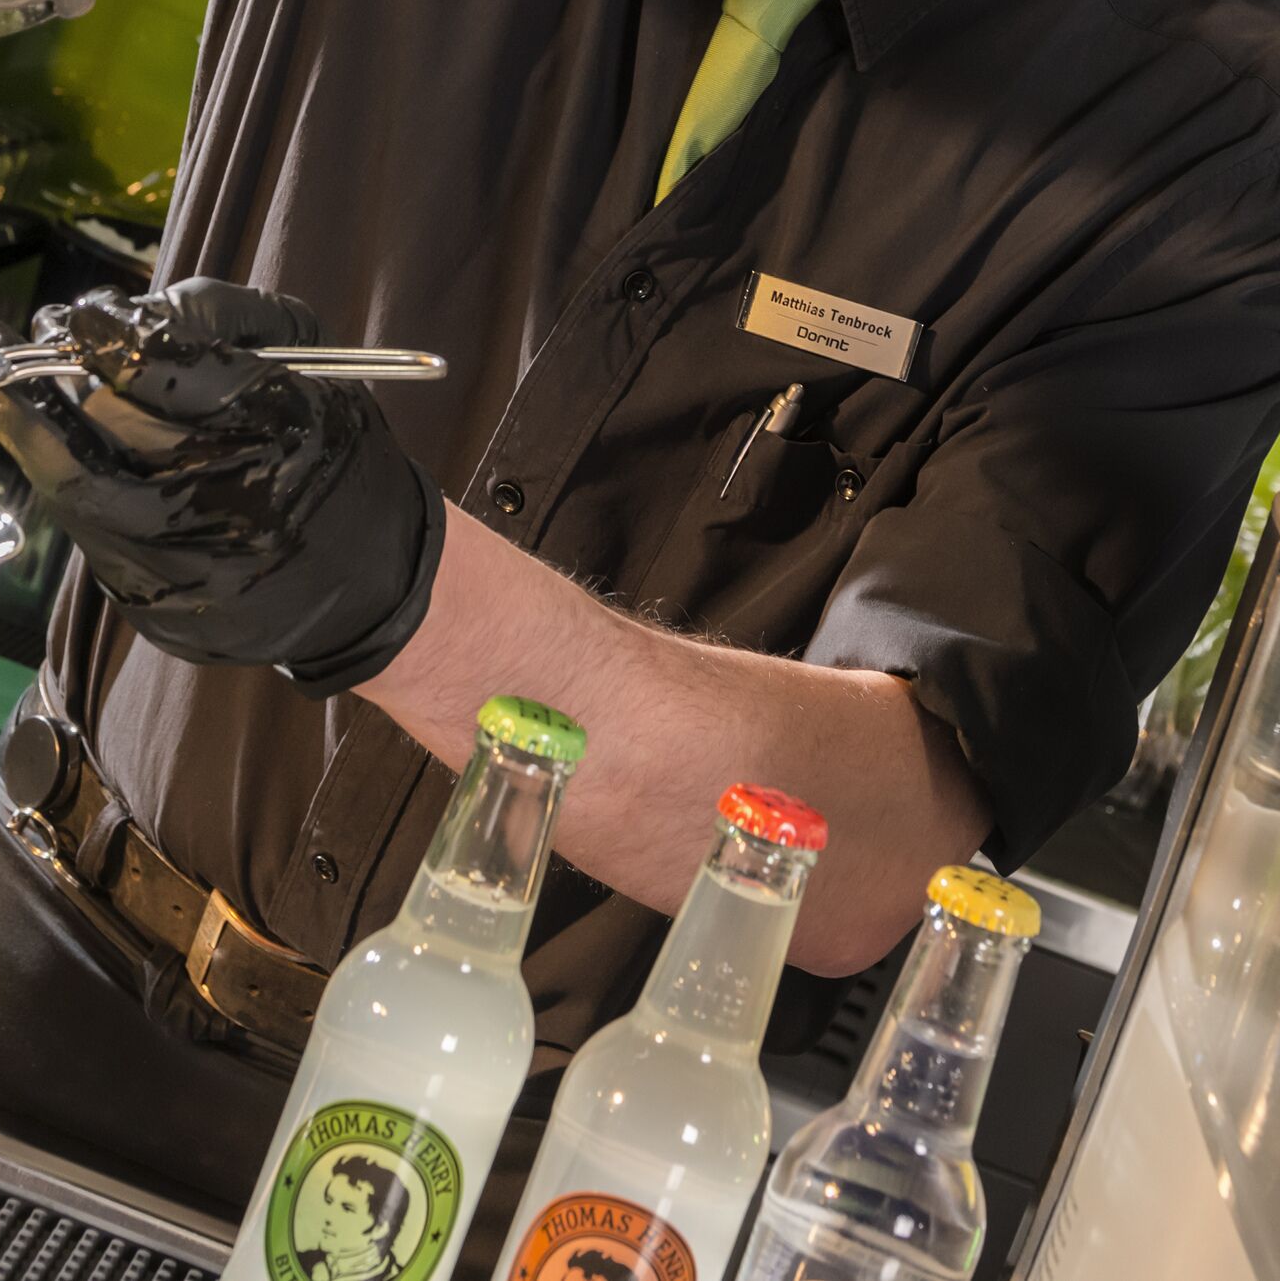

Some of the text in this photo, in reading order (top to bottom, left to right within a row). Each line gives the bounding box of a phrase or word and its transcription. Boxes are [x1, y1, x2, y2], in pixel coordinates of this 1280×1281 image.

[770, 290, 893, 339] Matthias Tenbrock
[797, 326, 850, 352] Dorint
[304, 1112, 453, 1198] THOMAS HENRY
[541, 1206, 687, 1281] THOMAS HENR
